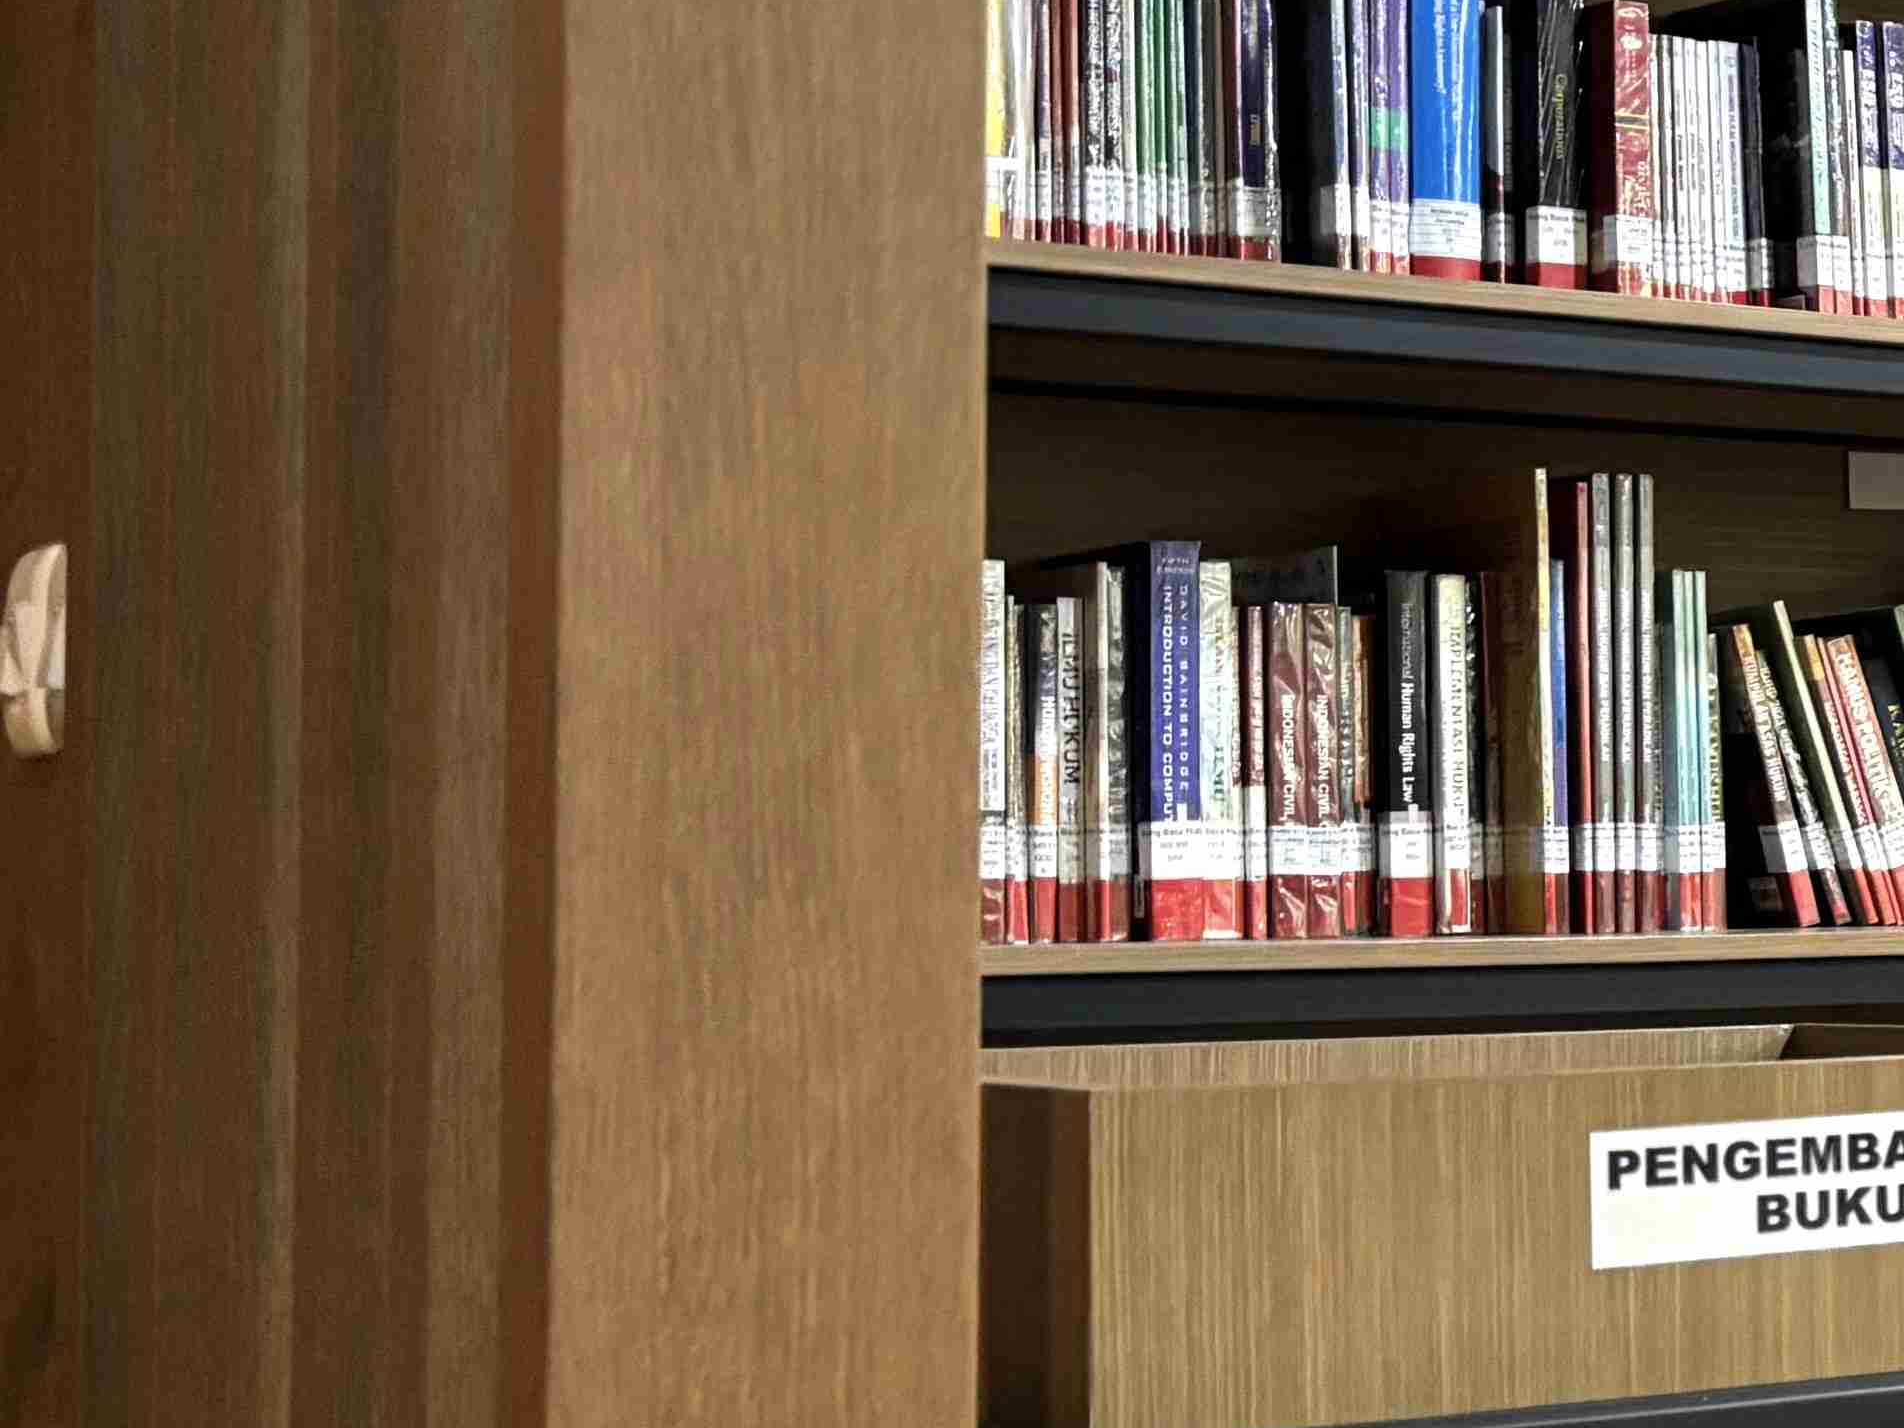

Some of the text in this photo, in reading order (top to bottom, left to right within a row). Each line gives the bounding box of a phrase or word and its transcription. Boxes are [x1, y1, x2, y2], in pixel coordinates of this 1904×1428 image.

[1162, 585, 1173, 717] INTRODUCTION
[1179, 584, 1189, 791] DAVID BAINBRIDGE
[1398, 602, 1417, 803] International Human Rights Law
[1063, 694, 1081, 784] HUKUM
[1162, 722, 1173, 746] TO
[1316, 783, 1330, 819] CIVIL
